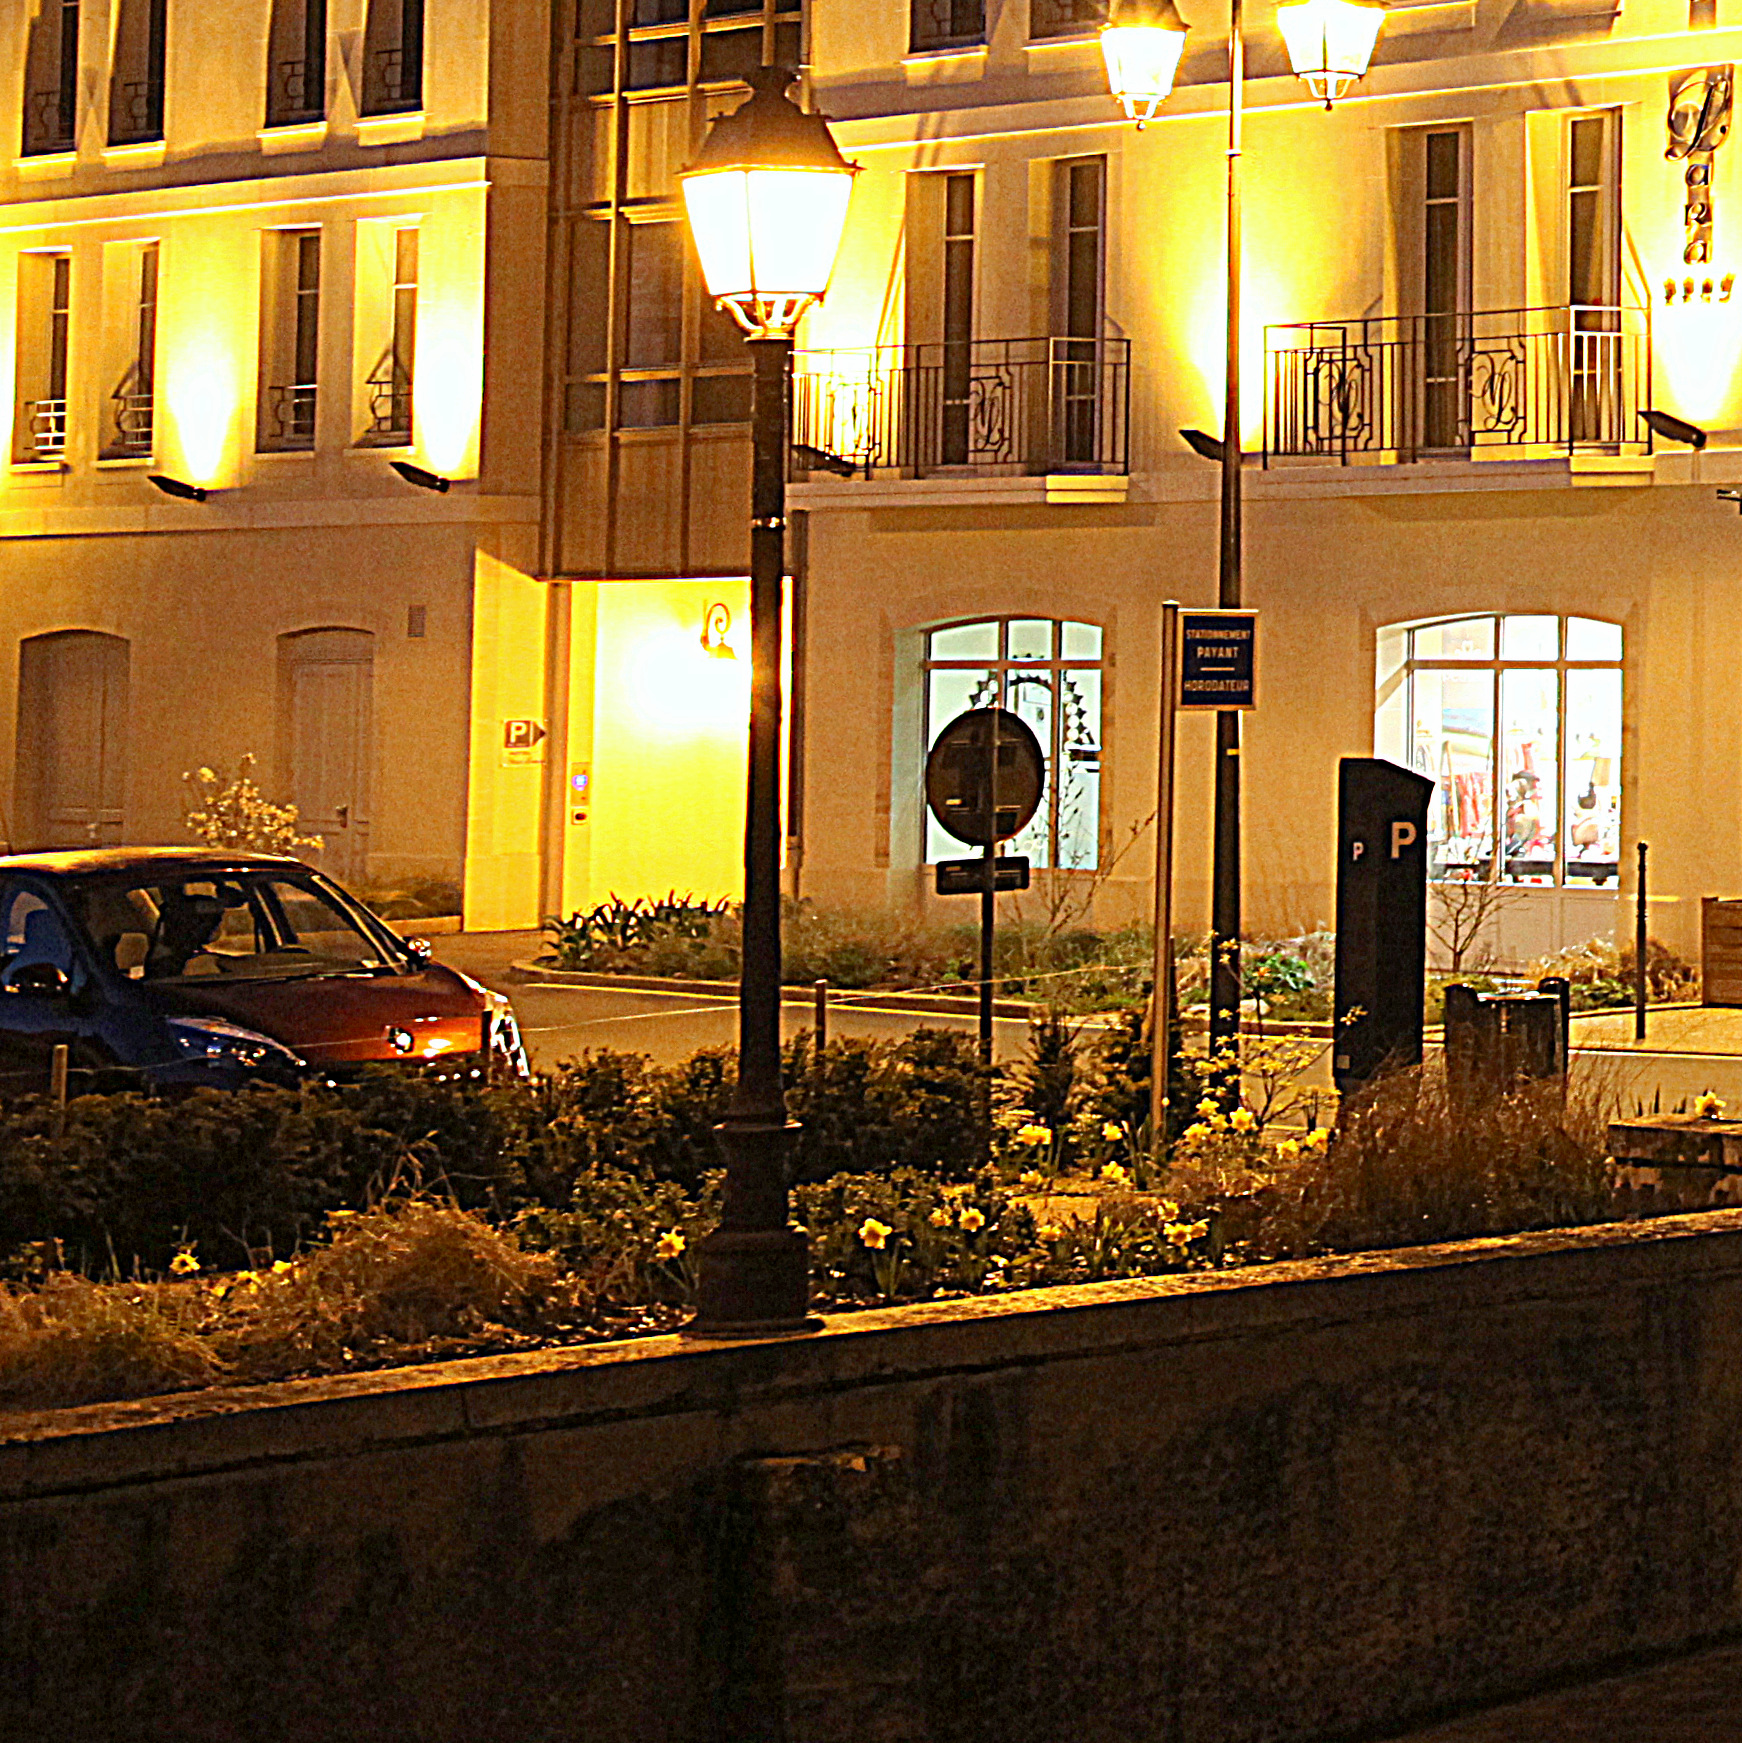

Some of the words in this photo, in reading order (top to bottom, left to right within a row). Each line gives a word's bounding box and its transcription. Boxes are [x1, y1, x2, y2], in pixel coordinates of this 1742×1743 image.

[1196, 647, 1239, 658] PAYANT
[1184, 680, 1250, 691] HORODATEUR
[510, 722, 527, 743] P
[1391, 822, 1417, 858] P
[1353, 842, 1364, 860] P
